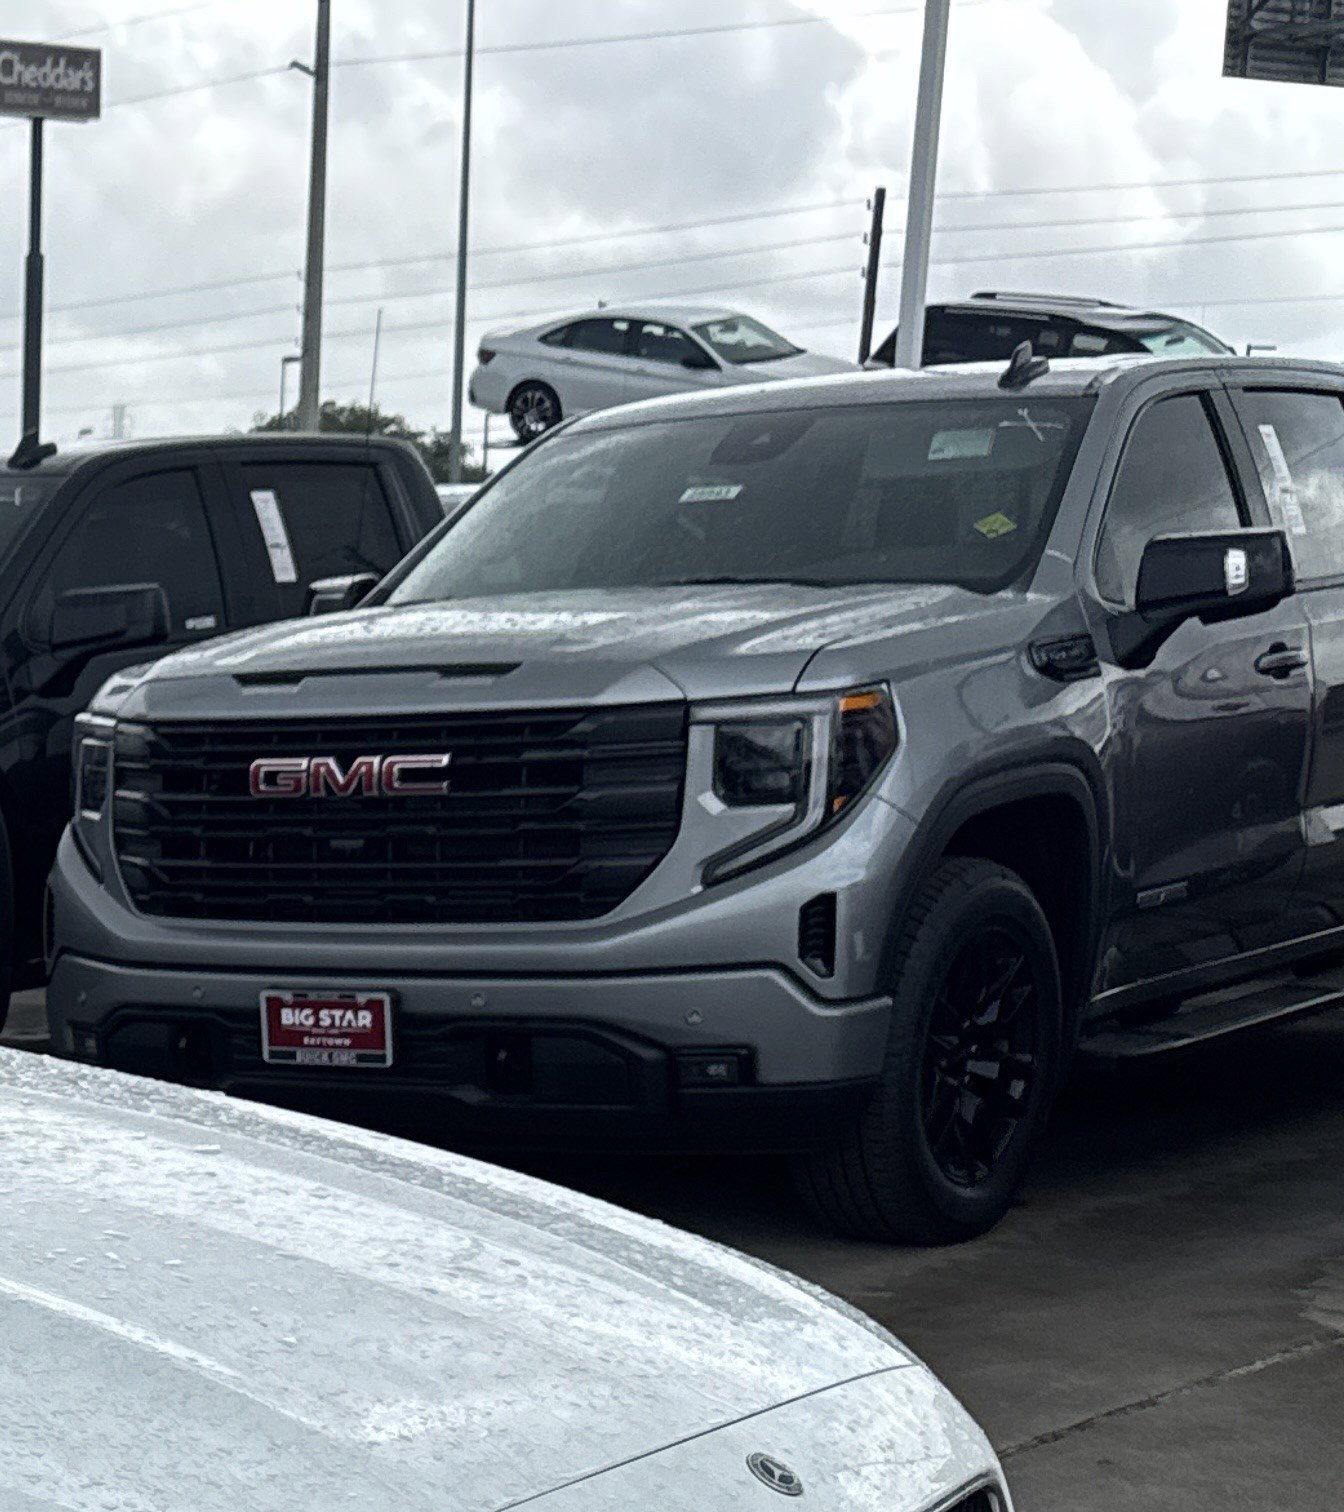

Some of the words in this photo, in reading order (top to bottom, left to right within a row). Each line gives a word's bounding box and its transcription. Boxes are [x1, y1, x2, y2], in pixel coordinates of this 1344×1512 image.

[249, 751, 452, 797] GMC
[280, 1007, 315, 1026] BIG
[318, 1008, 373, 1028] STAR
